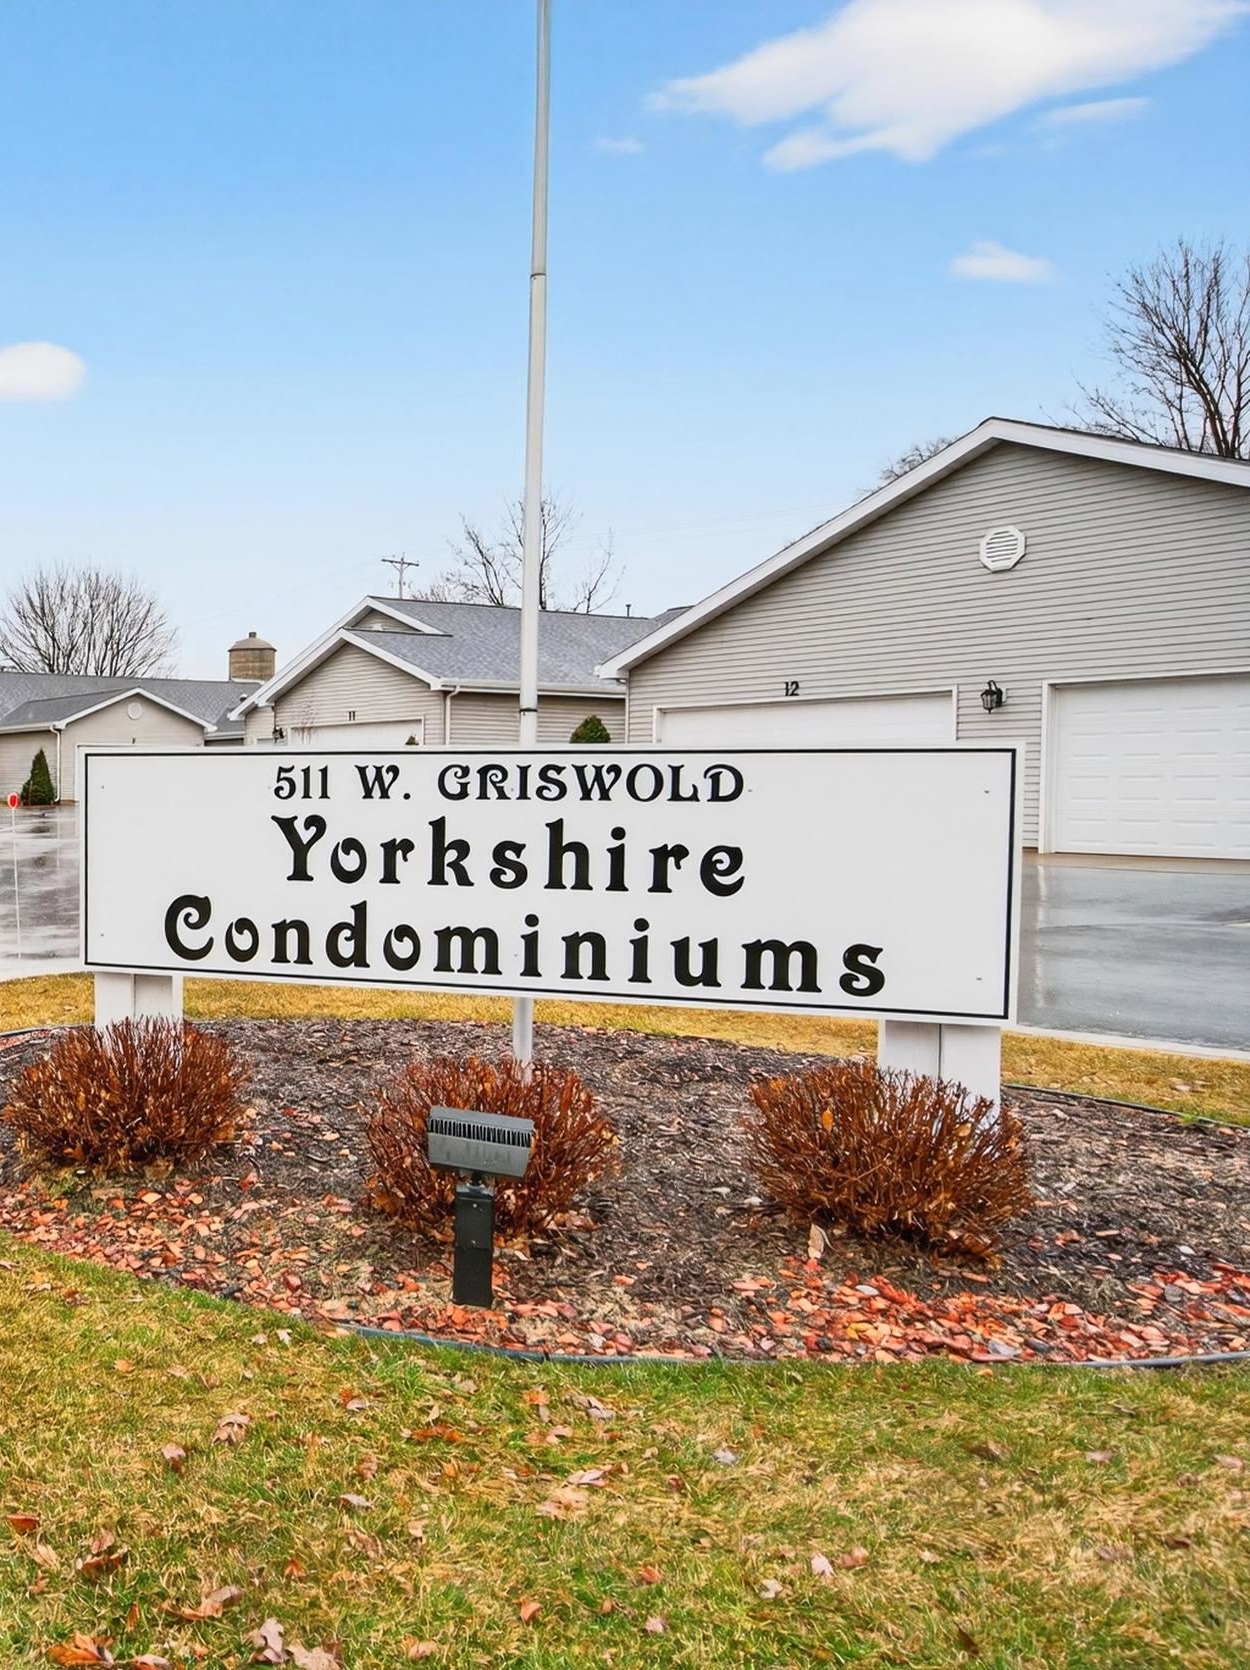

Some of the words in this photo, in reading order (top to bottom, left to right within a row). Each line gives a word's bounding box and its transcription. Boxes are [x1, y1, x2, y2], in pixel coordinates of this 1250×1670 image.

[784, 681, 800, 697] 12
[273, 765, 331, 800] 511
[354, 764, 412, 801] W.
[438, 763, 745, 803] GRISWOLD
[270, 814, 745, 897] Yorkshire
[164, 894, 886, 997] Condominiums
